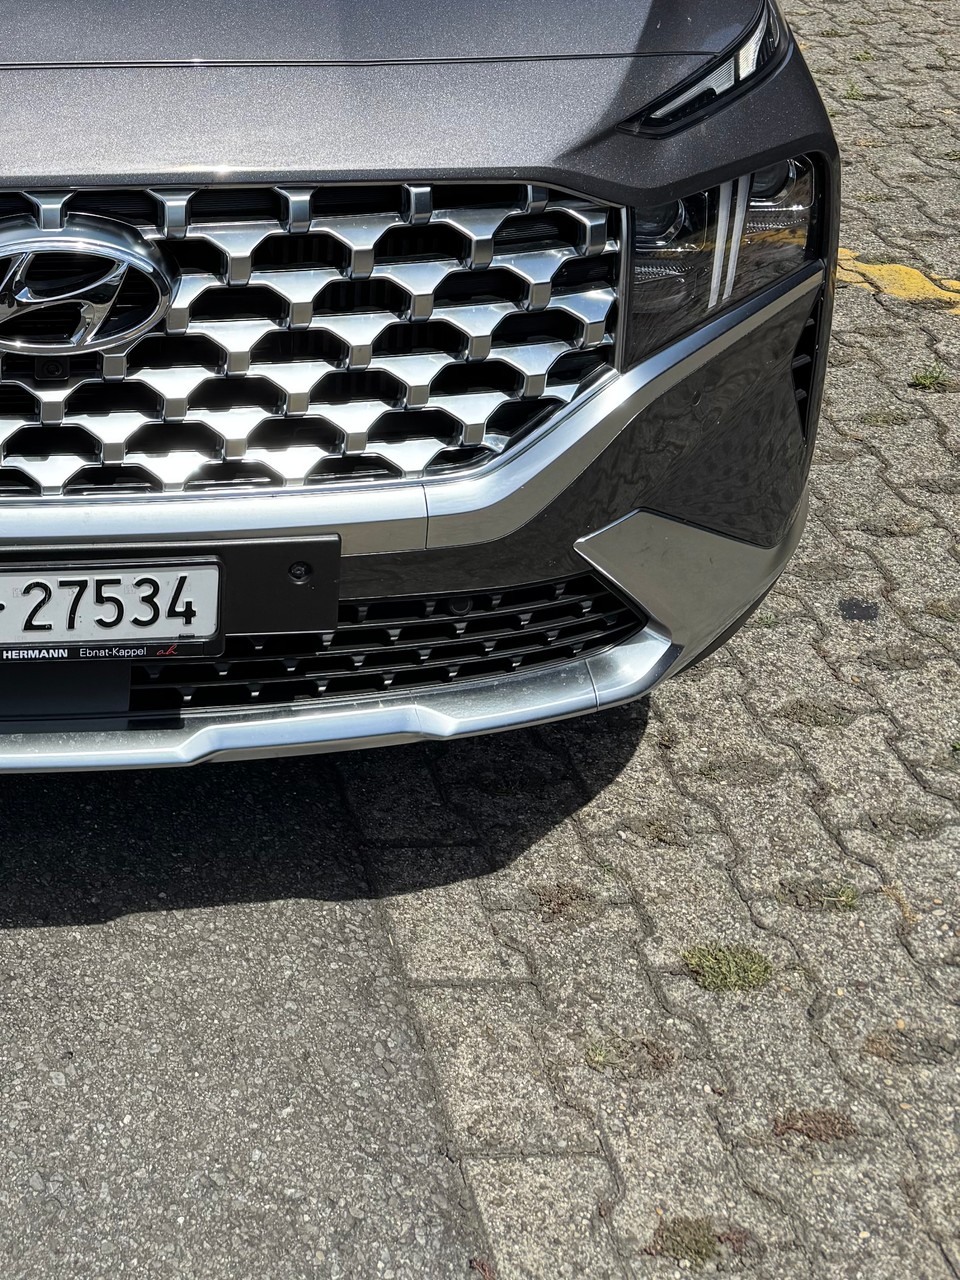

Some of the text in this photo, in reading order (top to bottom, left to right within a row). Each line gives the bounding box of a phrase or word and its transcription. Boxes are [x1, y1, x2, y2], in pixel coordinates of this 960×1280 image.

[22, 574, 197, 632] 27534
[3, 649, 68, 659] HERMANN
[79, 646, 147, 658] Ebnat-Kappel
